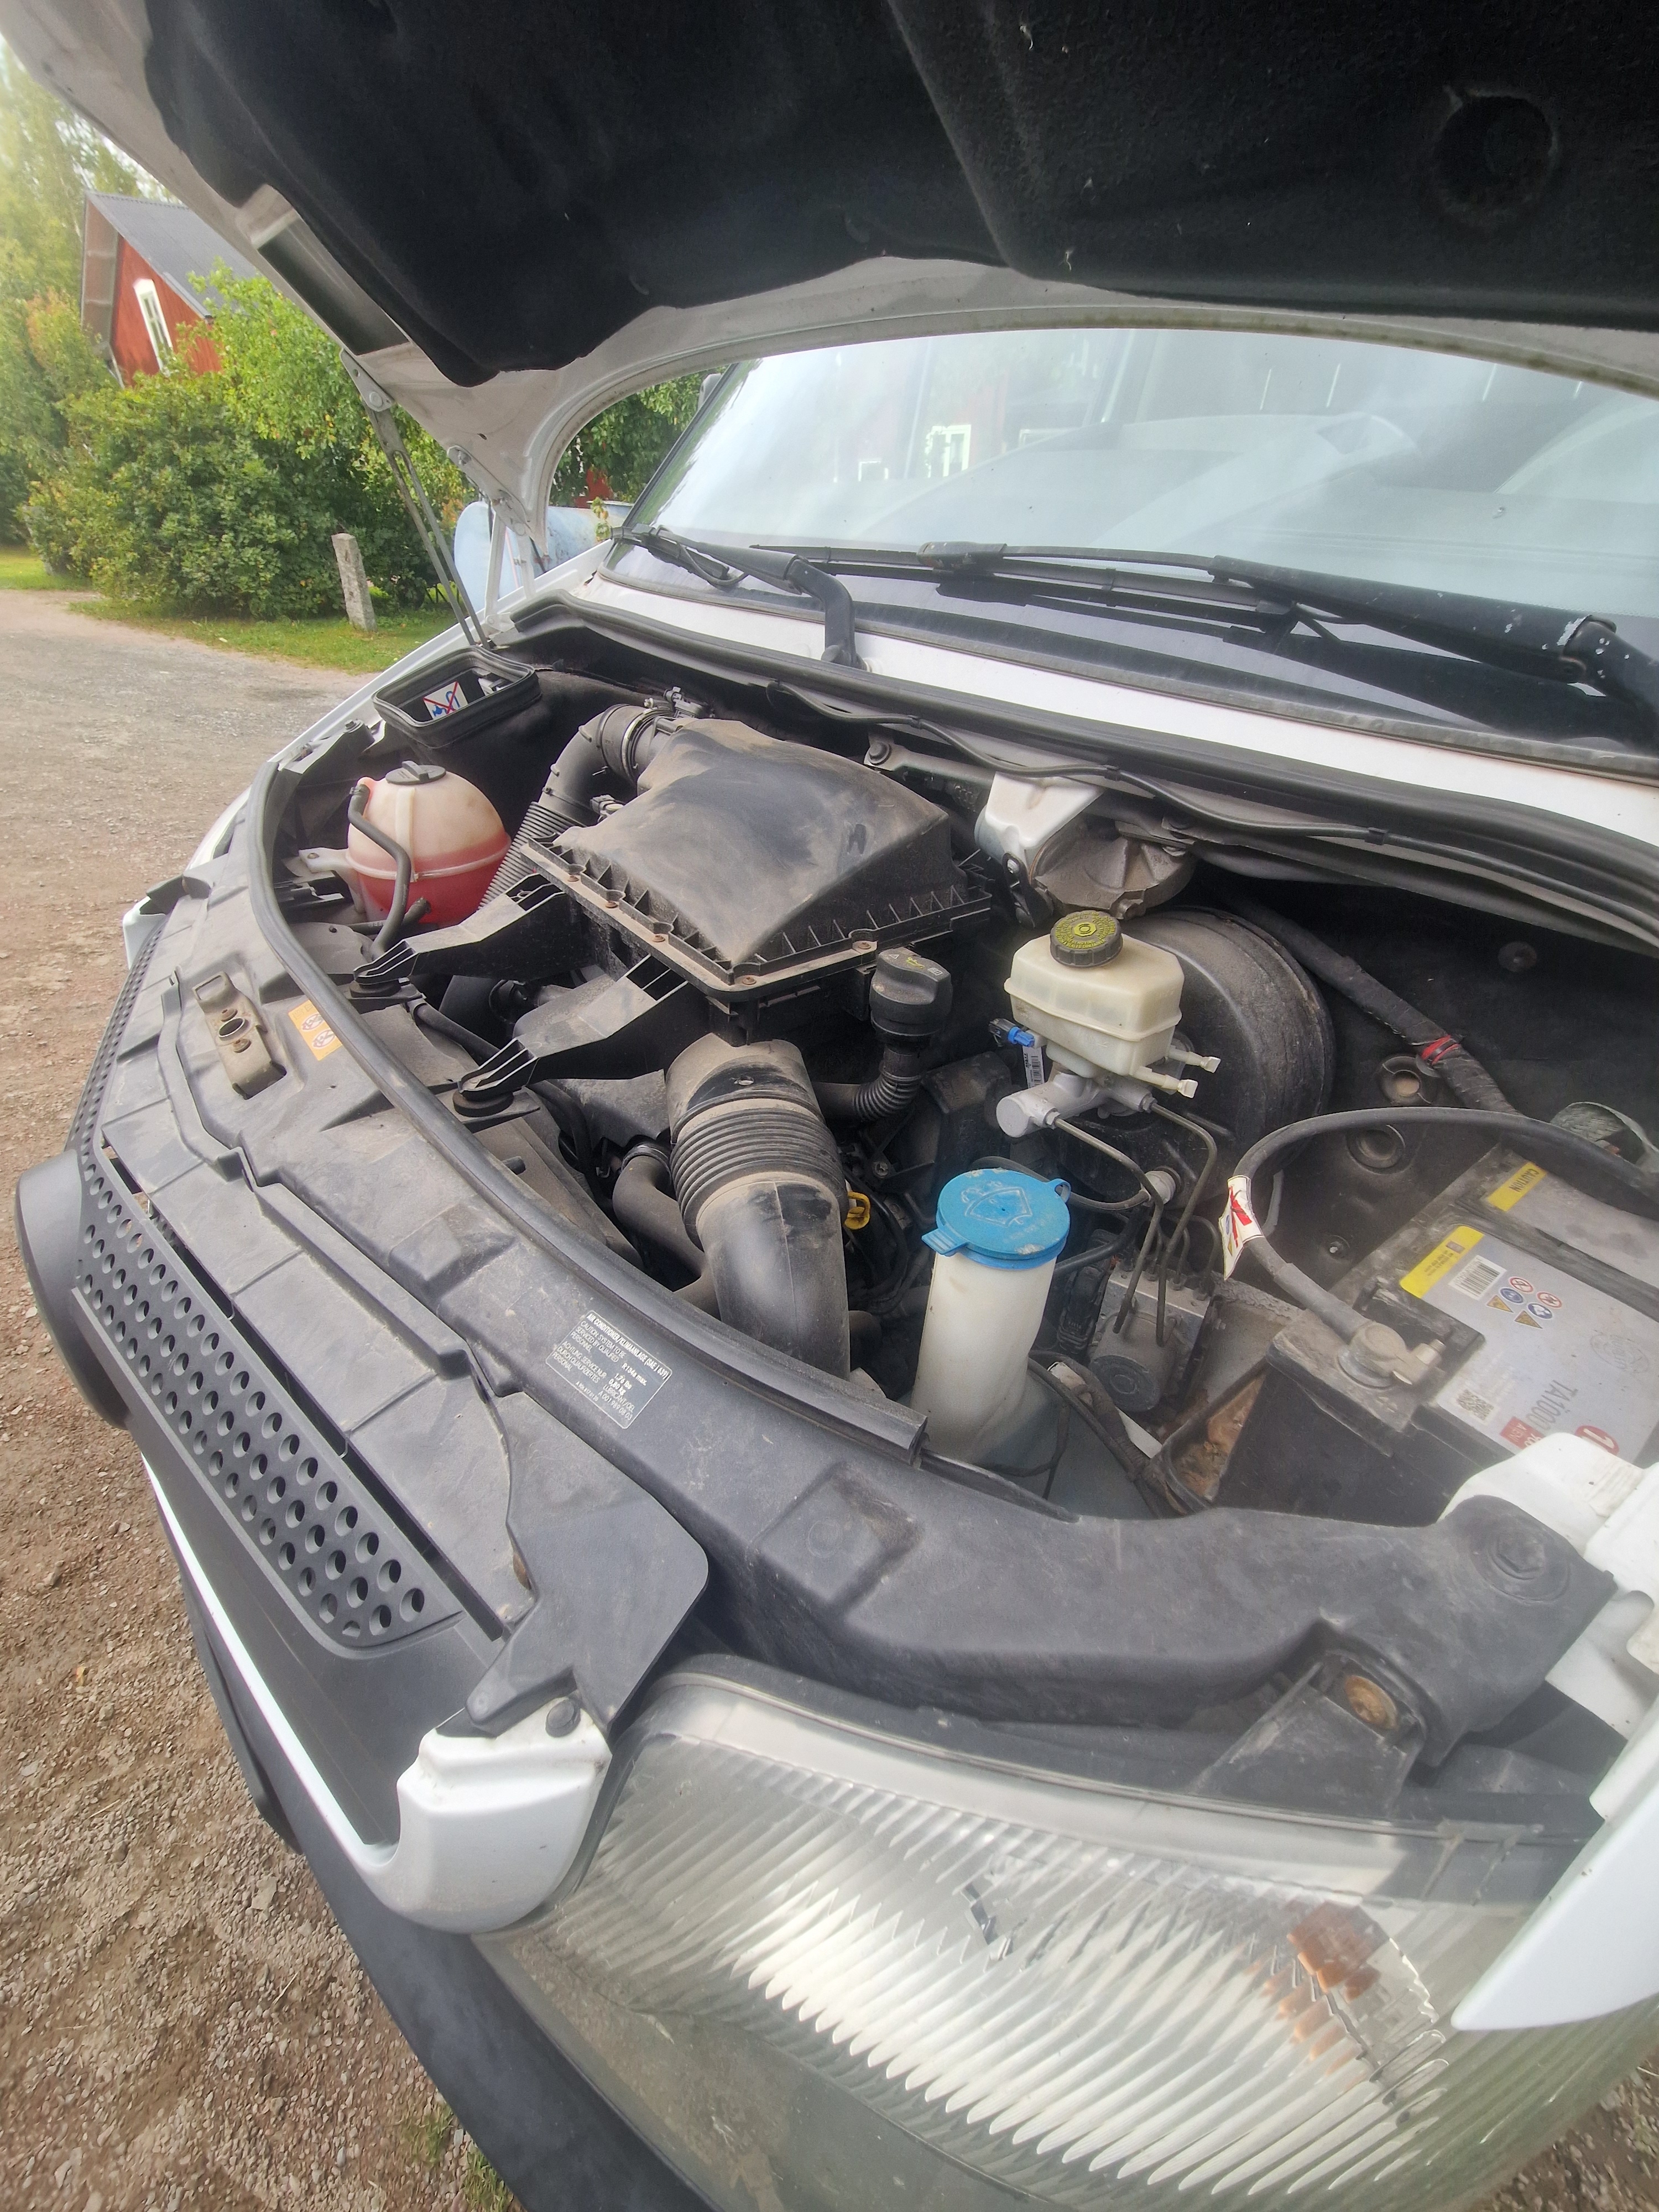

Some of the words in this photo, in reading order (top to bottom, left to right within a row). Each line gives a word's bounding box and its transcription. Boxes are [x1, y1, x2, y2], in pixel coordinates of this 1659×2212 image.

[1509, 1168, 1540, 1193] CAUTION
[569, 1331, 594, 1352] PERSONNEL
[574, 1326, 596, 1344] SERVICED
[586, 1313, 596, 1322] AIR
[643, 1357, 658, 1370] (SAE
[655, 1366, 670, 1380] 639)
[597, 1334, 615, 1350] SYSTEM
[612, 1345, 621, 1354] TO
[618, 1350, 627, 1358] BE
[551, 1351, 573, 1371] PERSONAL
[556, 1345, 573, 1360] DURCH
[580, 1355, 599, 1372] SERVICE
[595, 1368, 607, 1379] NUR
[620, 1363, 638, 1378] R134a
[635, 1374, 648, 1386] max.
[607, 1378, 620, 1391] 0,80
[617, 1386, 627, 1396] kg
[613, 1372, 626, 1384] 1.76
[623, 1380, 633, 1390] lbs
[601, 1392, 612, 1404] 001
[610, 1400, 621, 1411] 989
[618, 1406, 627, 1416] 08
[624, 1411, 633, 1421] 03
[1525, 1380, 1579, 1431] TA1000
